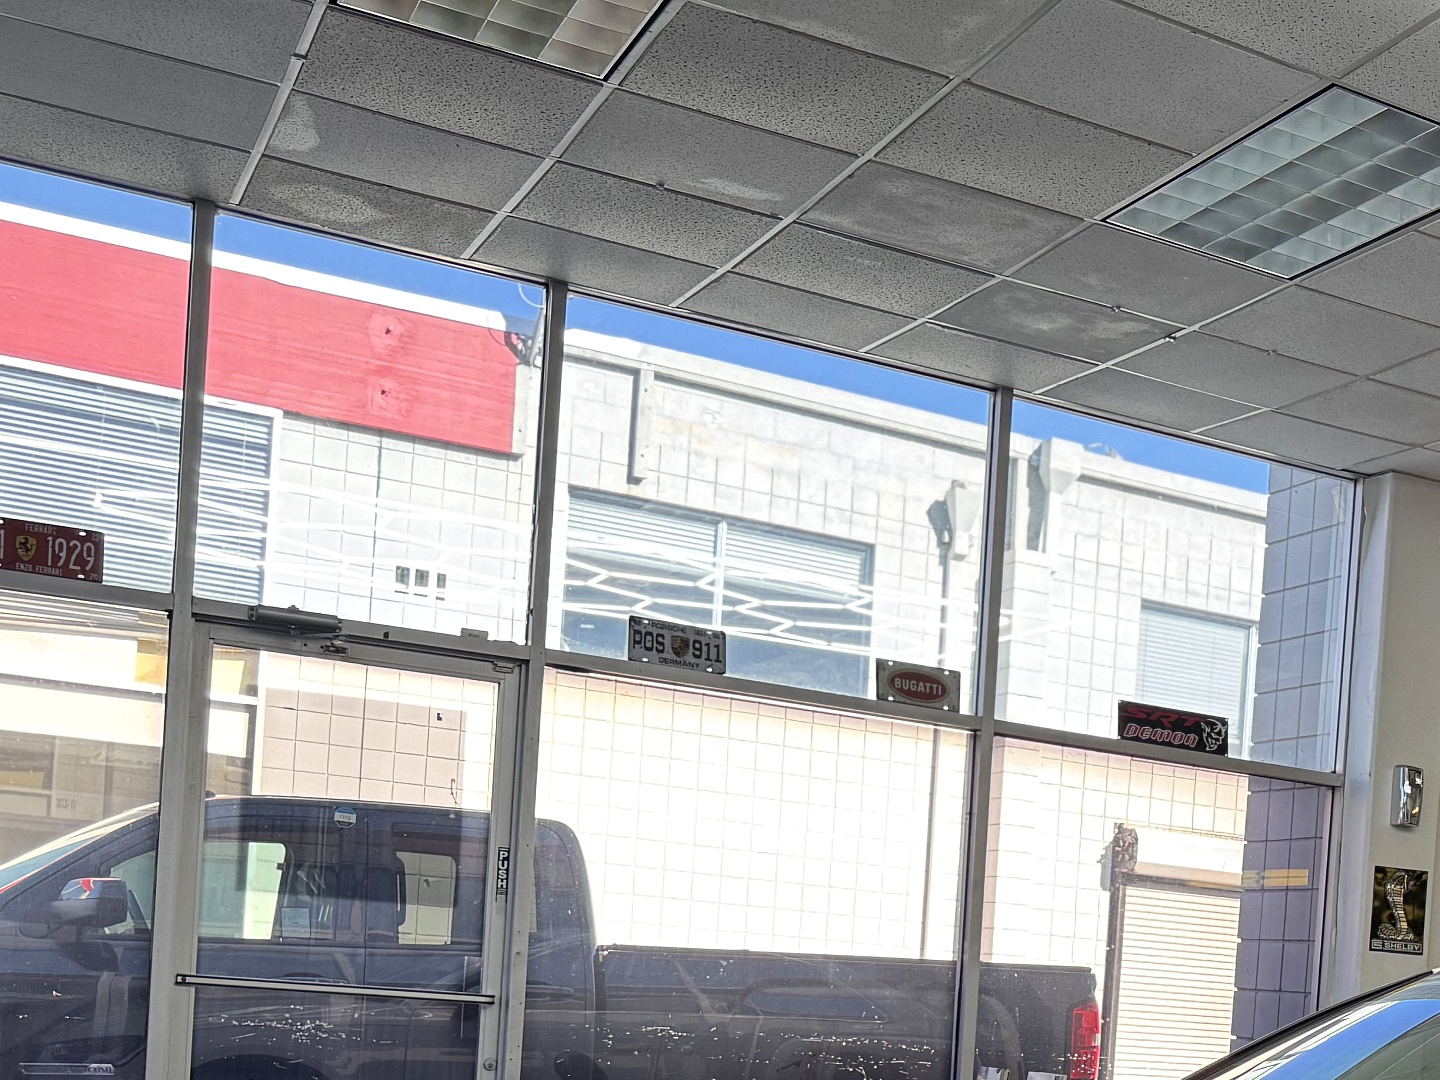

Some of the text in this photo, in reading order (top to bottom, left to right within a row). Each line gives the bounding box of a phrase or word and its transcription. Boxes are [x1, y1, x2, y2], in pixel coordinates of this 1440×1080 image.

[25, 523, 57, 536] FERRARI
[47, 536, 95, 571] 1929
[16, 562, 63, 577] ENZO FERRARI
[651, 621, 687, 634] PORSCHE
[632, 629, 723, 664] POS 911
[658, 657, 701, 669] GERMANY
[894, 677, 942, 696] BUGATTI
[1121, 704, 1205, 729] SRT
[1123, 723, 1199, 748] DEMON
[497, 850, 508, 889] PUSH
[1384, 942, 1420, 951] SHELBY
